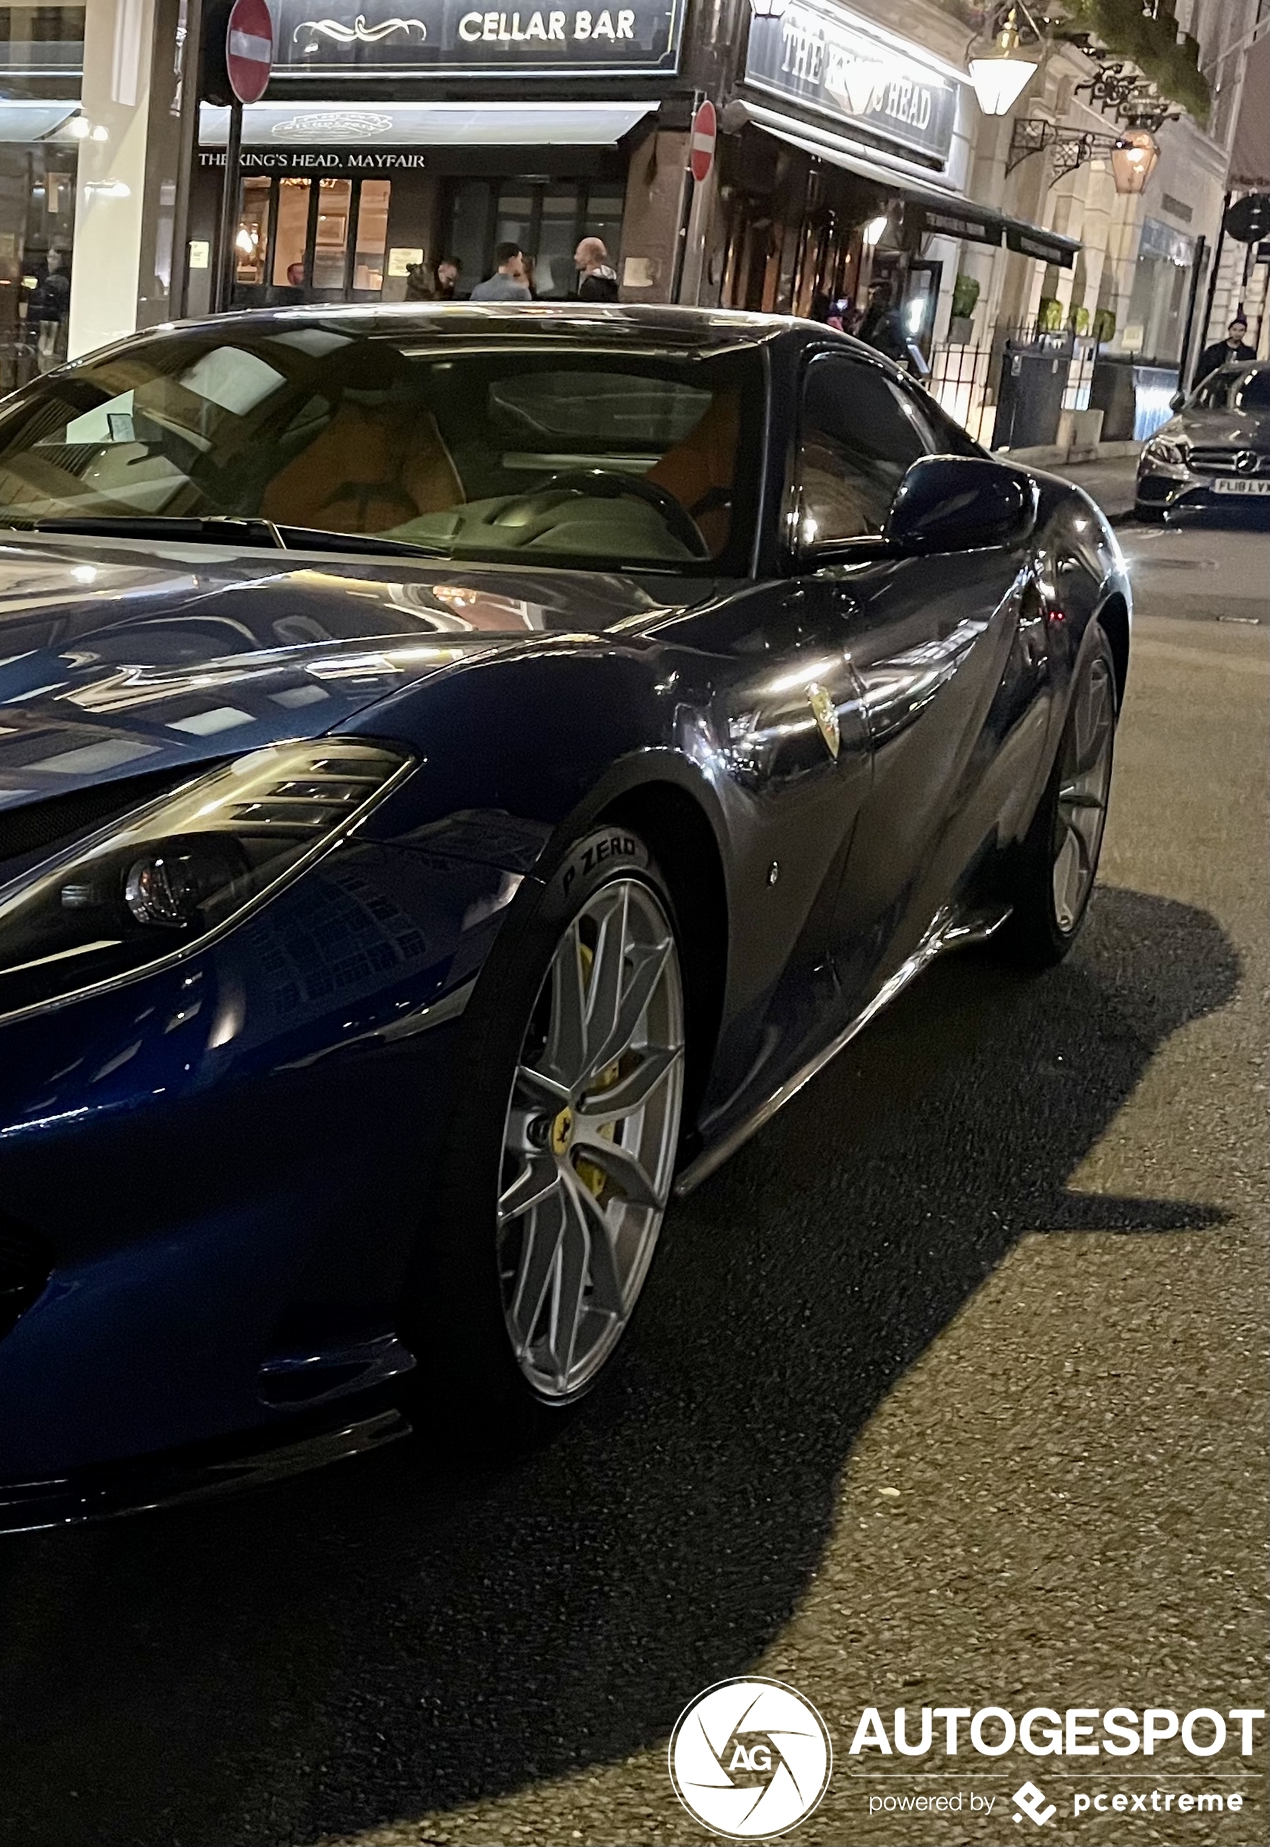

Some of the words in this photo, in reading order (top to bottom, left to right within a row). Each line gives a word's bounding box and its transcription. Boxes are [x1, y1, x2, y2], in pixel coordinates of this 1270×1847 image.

[459, 11, 566, 41] CELLAR
[574, 9, 635, 40] BAR
[782, 22, 826, 85] THE
[885, 79, 931, 130] HEAD
[198, 153, 228, 167] THE
[347, 154, 426, 168] MAYFAIR
[562, 864, 576, 898] P
[580, 835, 636, 877] ZERO
